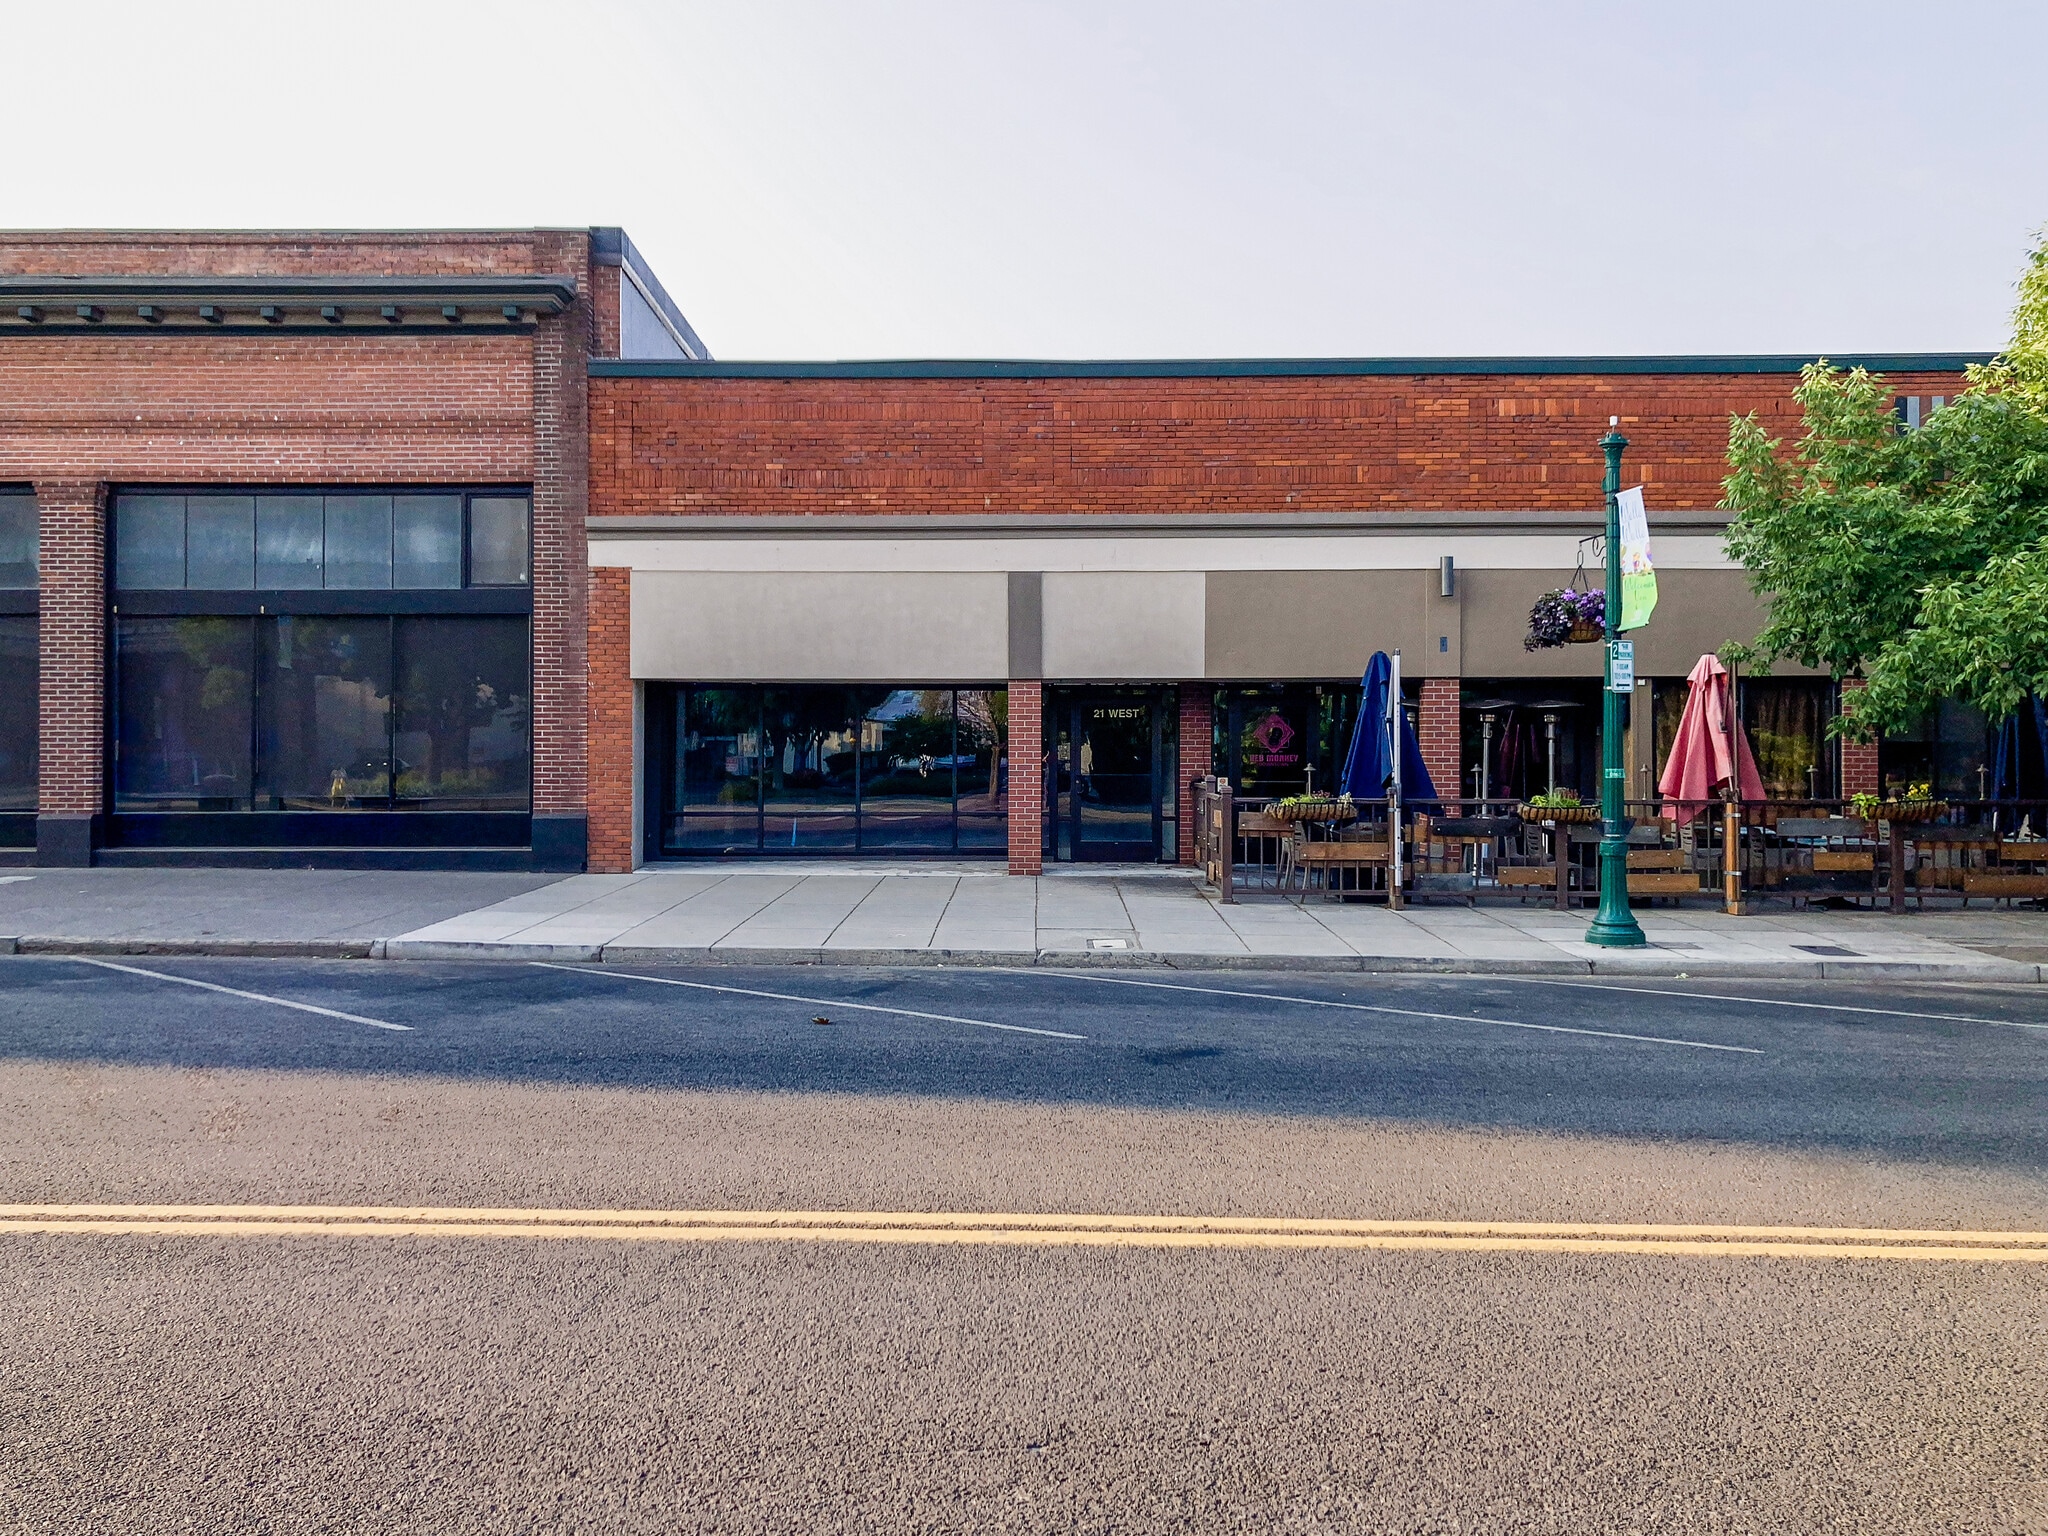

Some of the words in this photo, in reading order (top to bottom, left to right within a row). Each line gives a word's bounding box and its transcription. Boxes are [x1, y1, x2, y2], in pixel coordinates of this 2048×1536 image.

[1612, 644, 1618, 658] 2
[1093, 709, 1105, 718] 21
[1108, 709, 1140, 718] WEST
[1266, 754, 1299, 762] MONKEY
